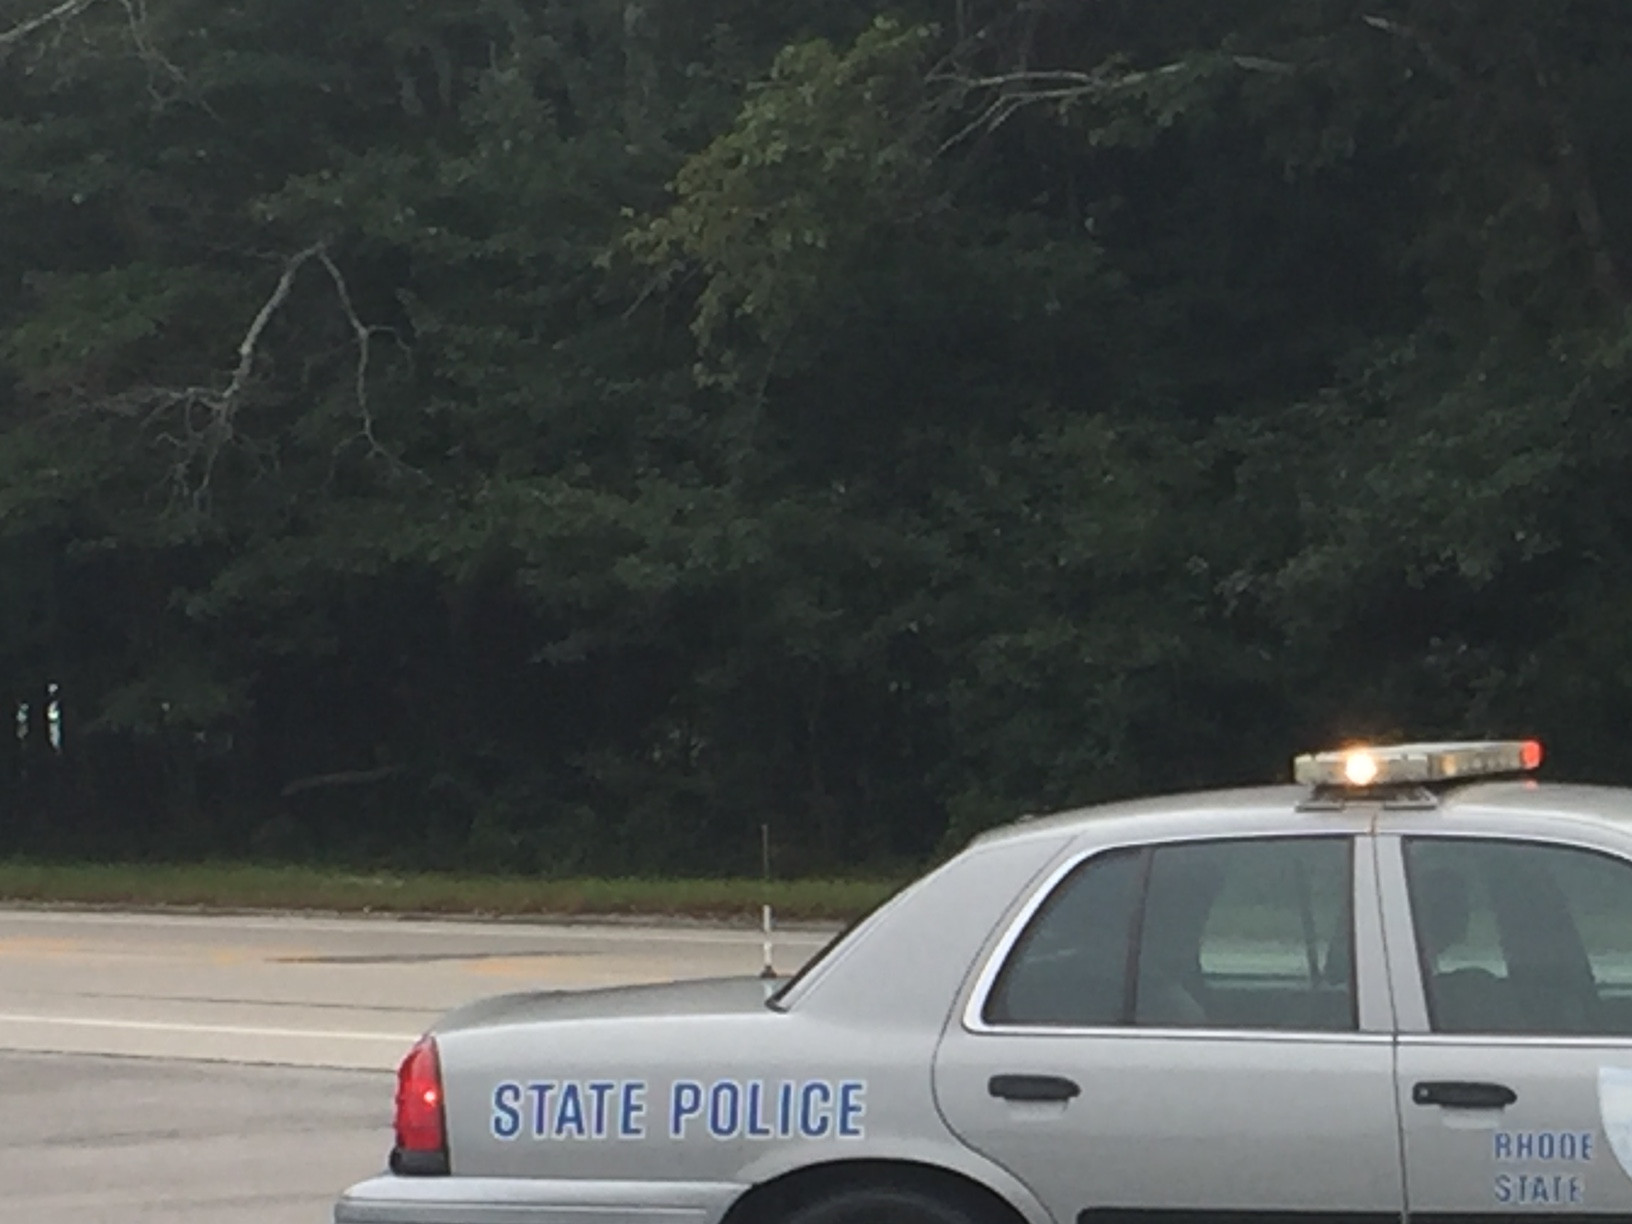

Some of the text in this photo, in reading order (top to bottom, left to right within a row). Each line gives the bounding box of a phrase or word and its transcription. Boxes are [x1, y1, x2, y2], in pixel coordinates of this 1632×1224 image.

[491, 1080, 866, 1139] STATE POLICE
[1494, 1131, 1593, 1161] RHODE
[1493, 1174, 1584, 1204] STATE
